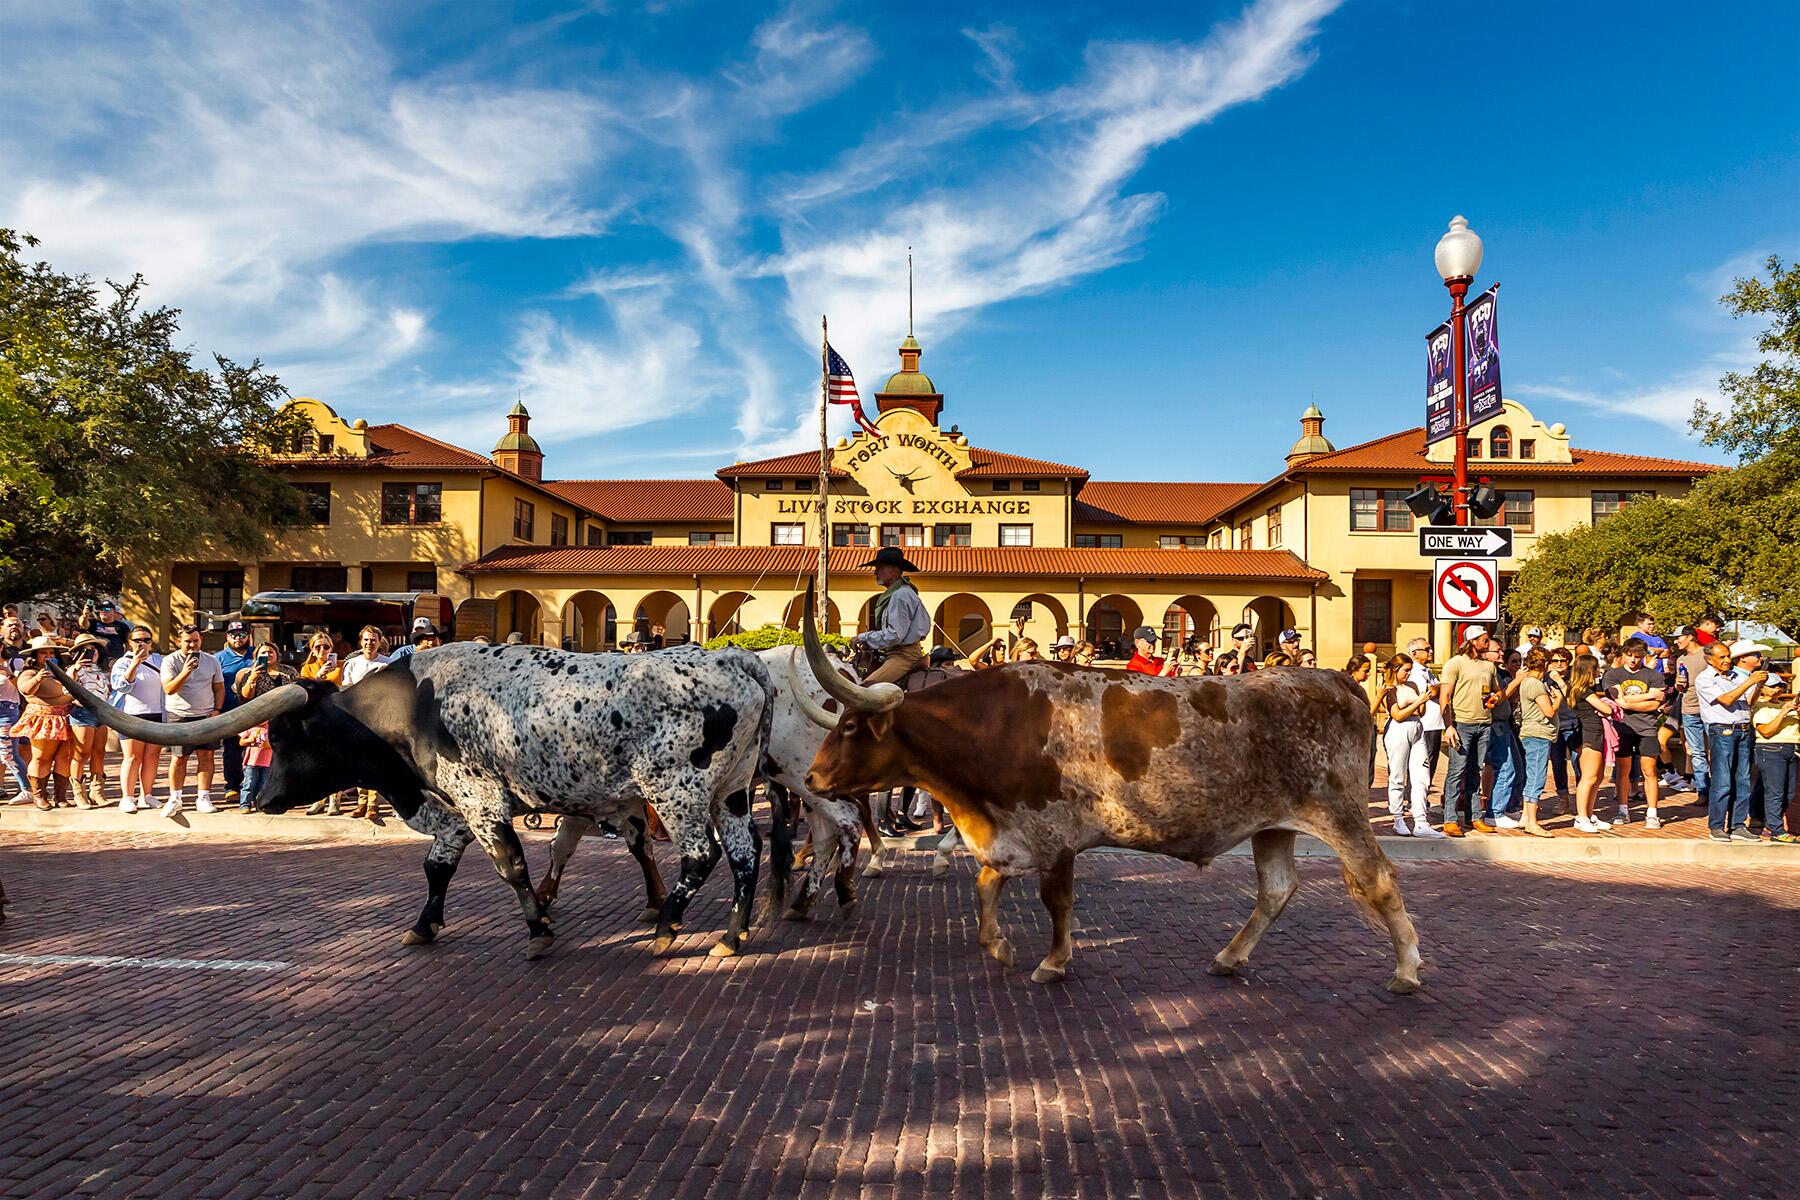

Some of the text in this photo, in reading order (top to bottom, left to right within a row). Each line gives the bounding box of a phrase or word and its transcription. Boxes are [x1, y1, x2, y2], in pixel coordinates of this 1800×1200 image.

[847, 433, 958, 472] FORT WORTH
[834, 500, 902, 514] STOCK
[912, 500, 1031, 514] EXCHANGE
[1428, 535, 1483, 548] ONE WAY
